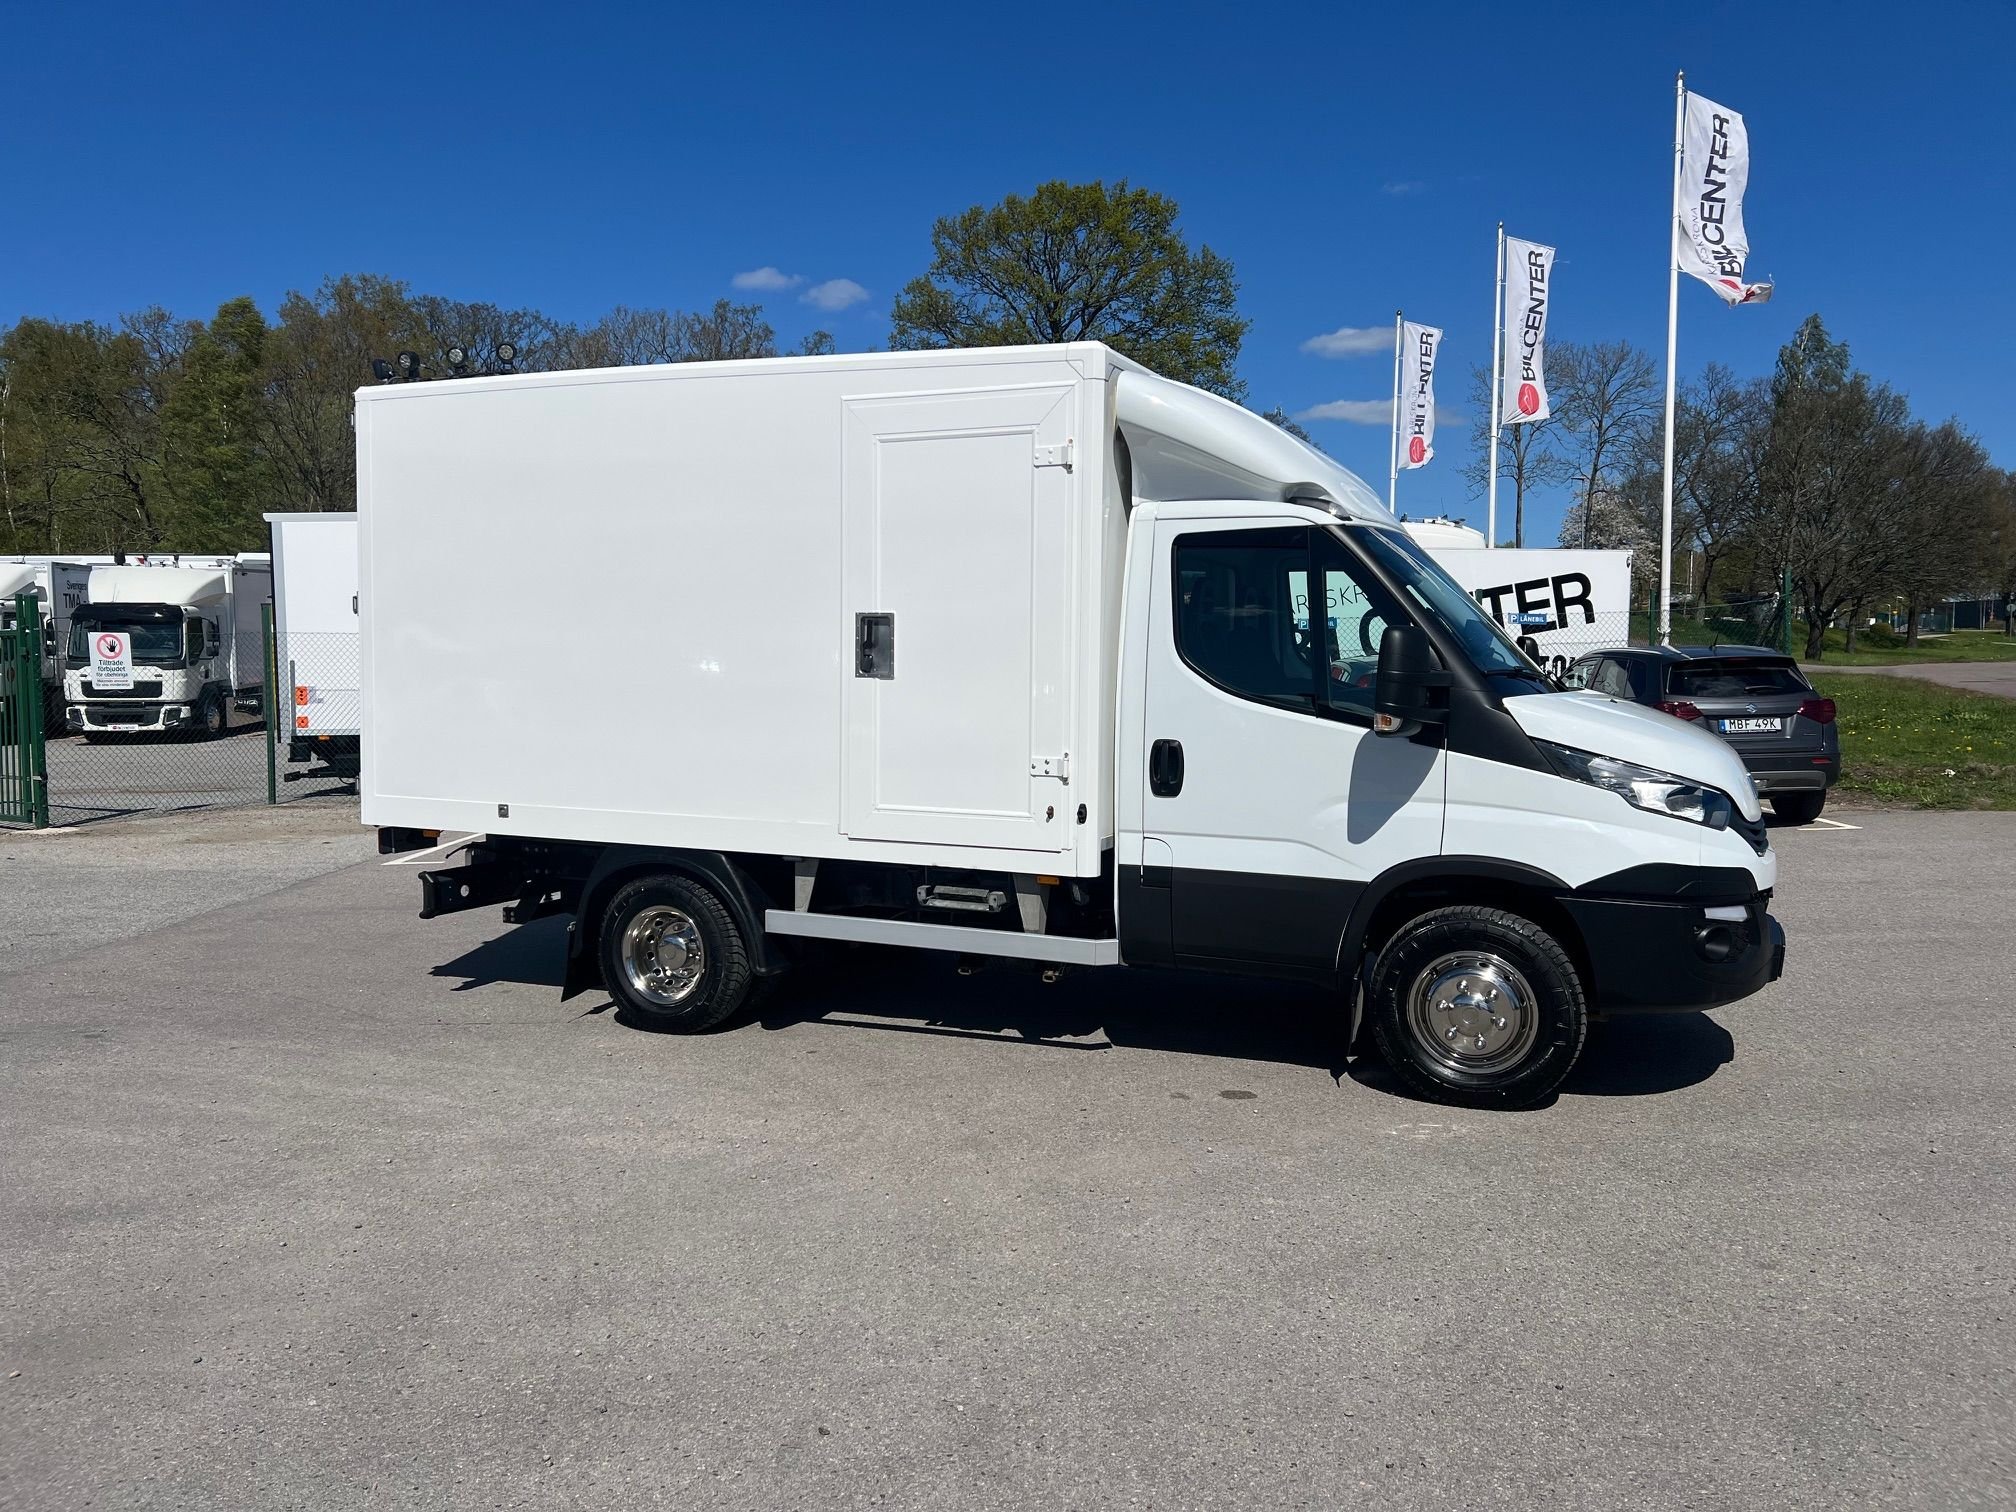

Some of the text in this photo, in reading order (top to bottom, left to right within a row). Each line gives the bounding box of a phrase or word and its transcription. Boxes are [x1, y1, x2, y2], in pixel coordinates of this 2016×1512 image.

[1701, 113, 1742, 278] BILCENTER
[1522, 250, 1546, 382] BILCENTER
[1469, 572, 1596, 635] TER
[1510, 615, 1517, 623] P
[1729, 718, 1777, 729] MBF 49K
